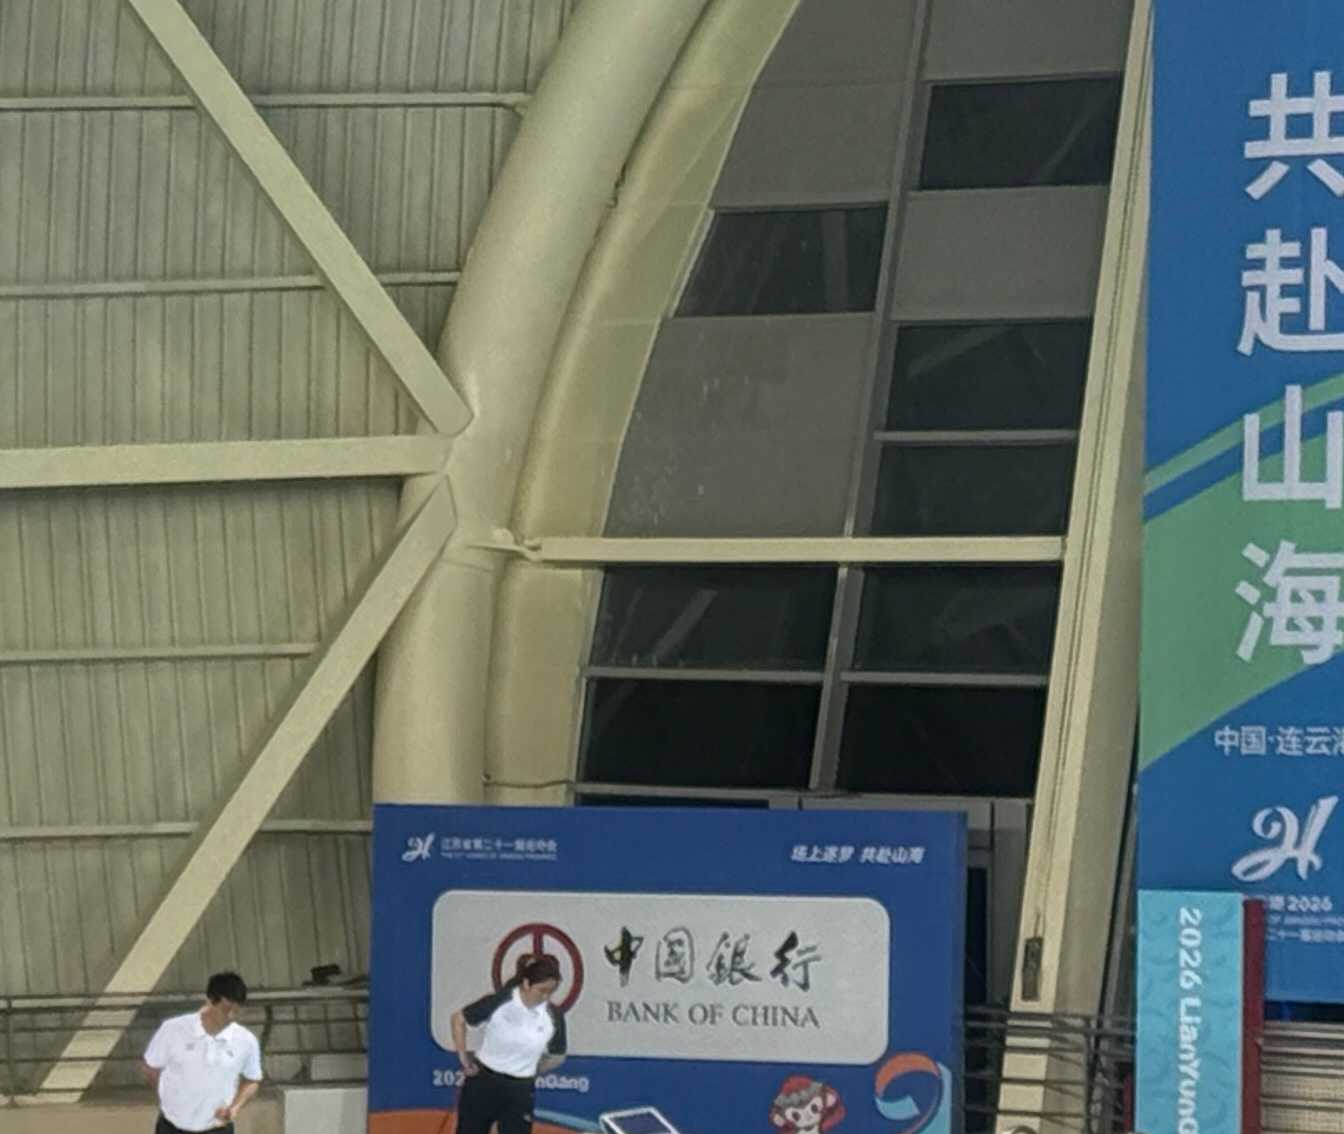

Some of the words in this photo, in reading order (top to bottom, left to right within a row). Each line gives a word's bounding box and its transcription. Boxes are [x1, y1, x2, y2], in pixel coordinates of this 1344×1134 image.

[1178, 907, 1202, 989] 2026
[606, 1001, 679, 1026] BANK
[688, 1003, 723, 1026] OF
[731, 1004, 821, 1030] CHINA
[433, 1069, 465, 1087] 202
